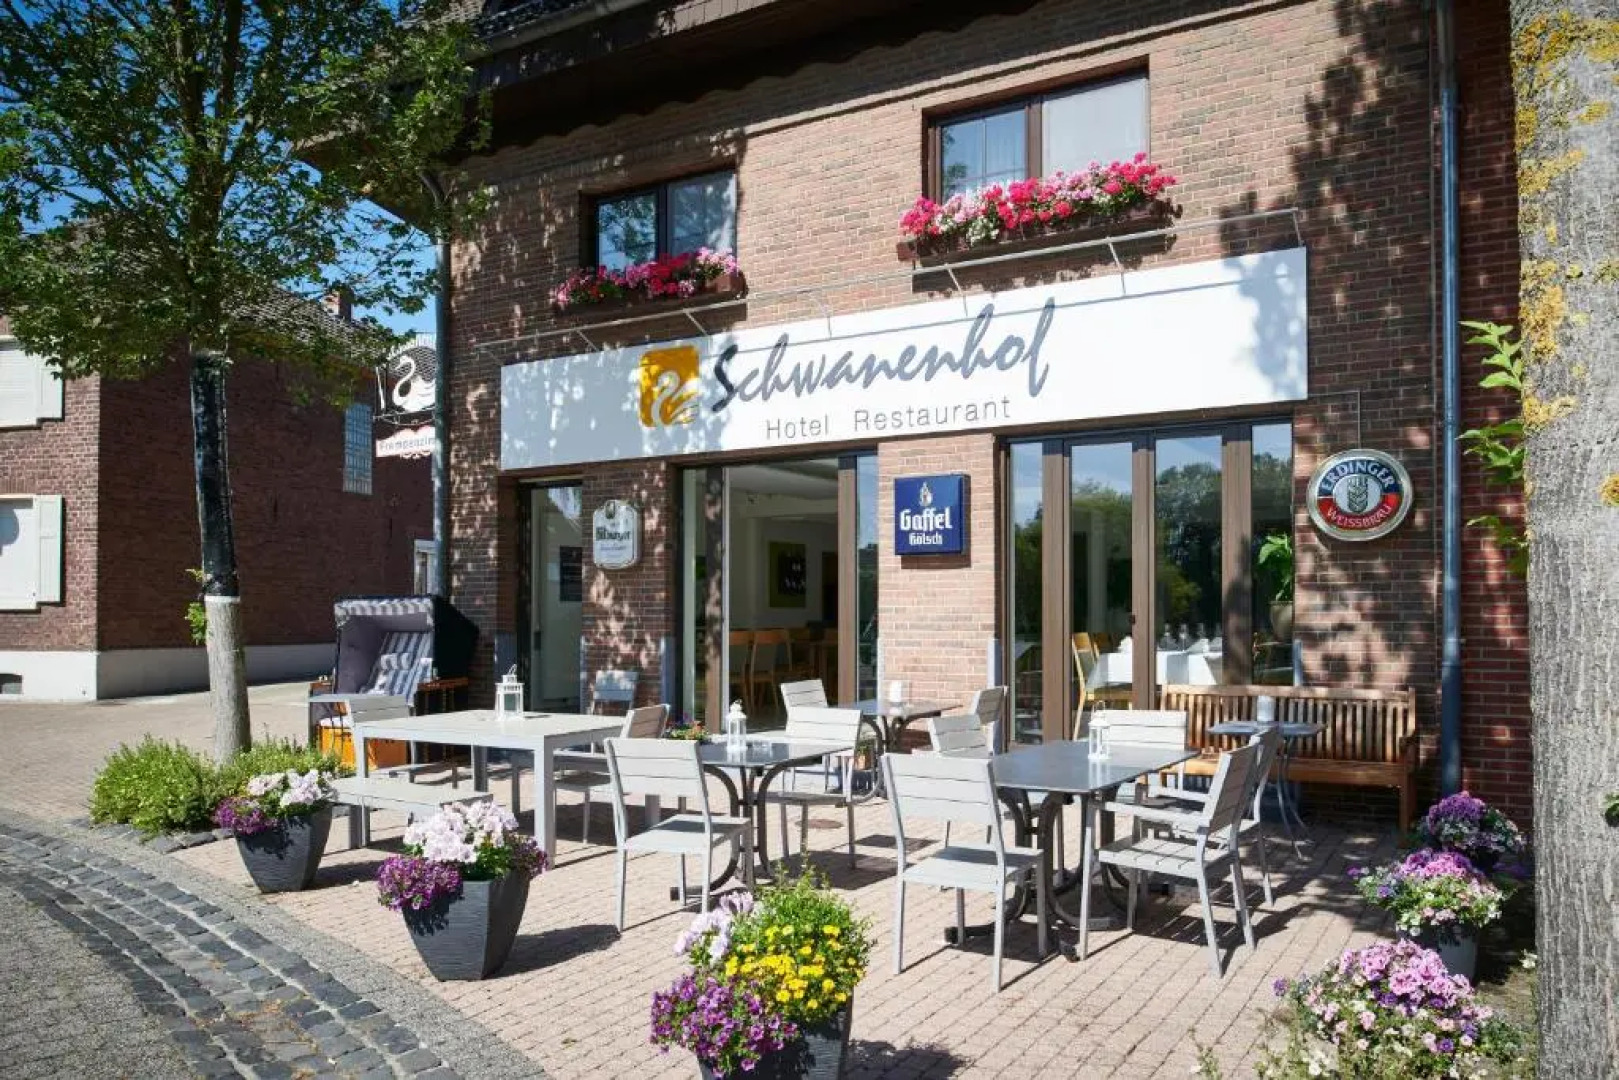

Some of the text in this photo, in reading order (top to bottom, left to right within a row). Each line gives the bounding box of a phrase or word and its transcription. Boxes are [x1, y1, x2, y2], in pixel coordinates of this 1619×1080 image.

[711, 296, 1056, 413] Schwanenhof
[766, 397, 1011, 441] Hotel Restaurant
[1321, 460, 1395, 490] ERDINGER
[900, 506, 953, 531] Gaffel
[908, 531, 943, 546] Kölsch
